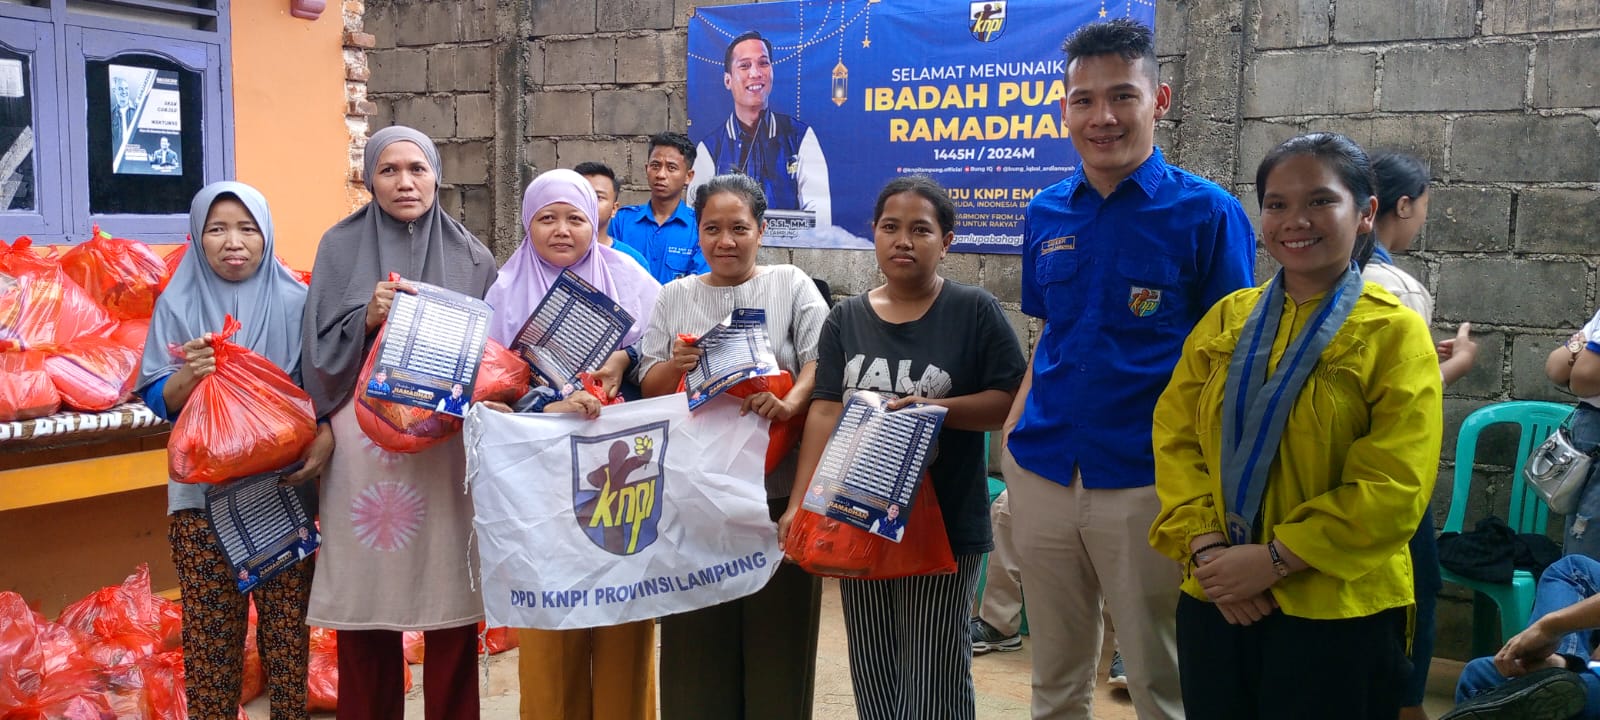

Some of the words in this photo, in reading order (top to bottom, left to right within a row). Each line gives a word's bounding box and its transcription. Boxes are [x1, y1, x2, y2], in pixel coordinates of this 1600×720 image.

[974, 12, 1003, 42] knpi
[891, 65, 966, 82] SELAMAT
[970, 60, 1065, 79] MENUNAIK
[864, 83, 988, 112] IBADAH
[933, 148, 976, 160] 1445H
[977, 147, 986, 161] /
[987, 147, 1036, 160] 2024M
[974, 188, 1008, 200] KNPI
[588, 467, 657, 554] knpi
[511, 589, 536, 608] DPD
[542, 590, 588, 609] KNPI
[594, 576, 675, 606] PROVINSI
[675, 551, 768, 591] LAMPUNG
